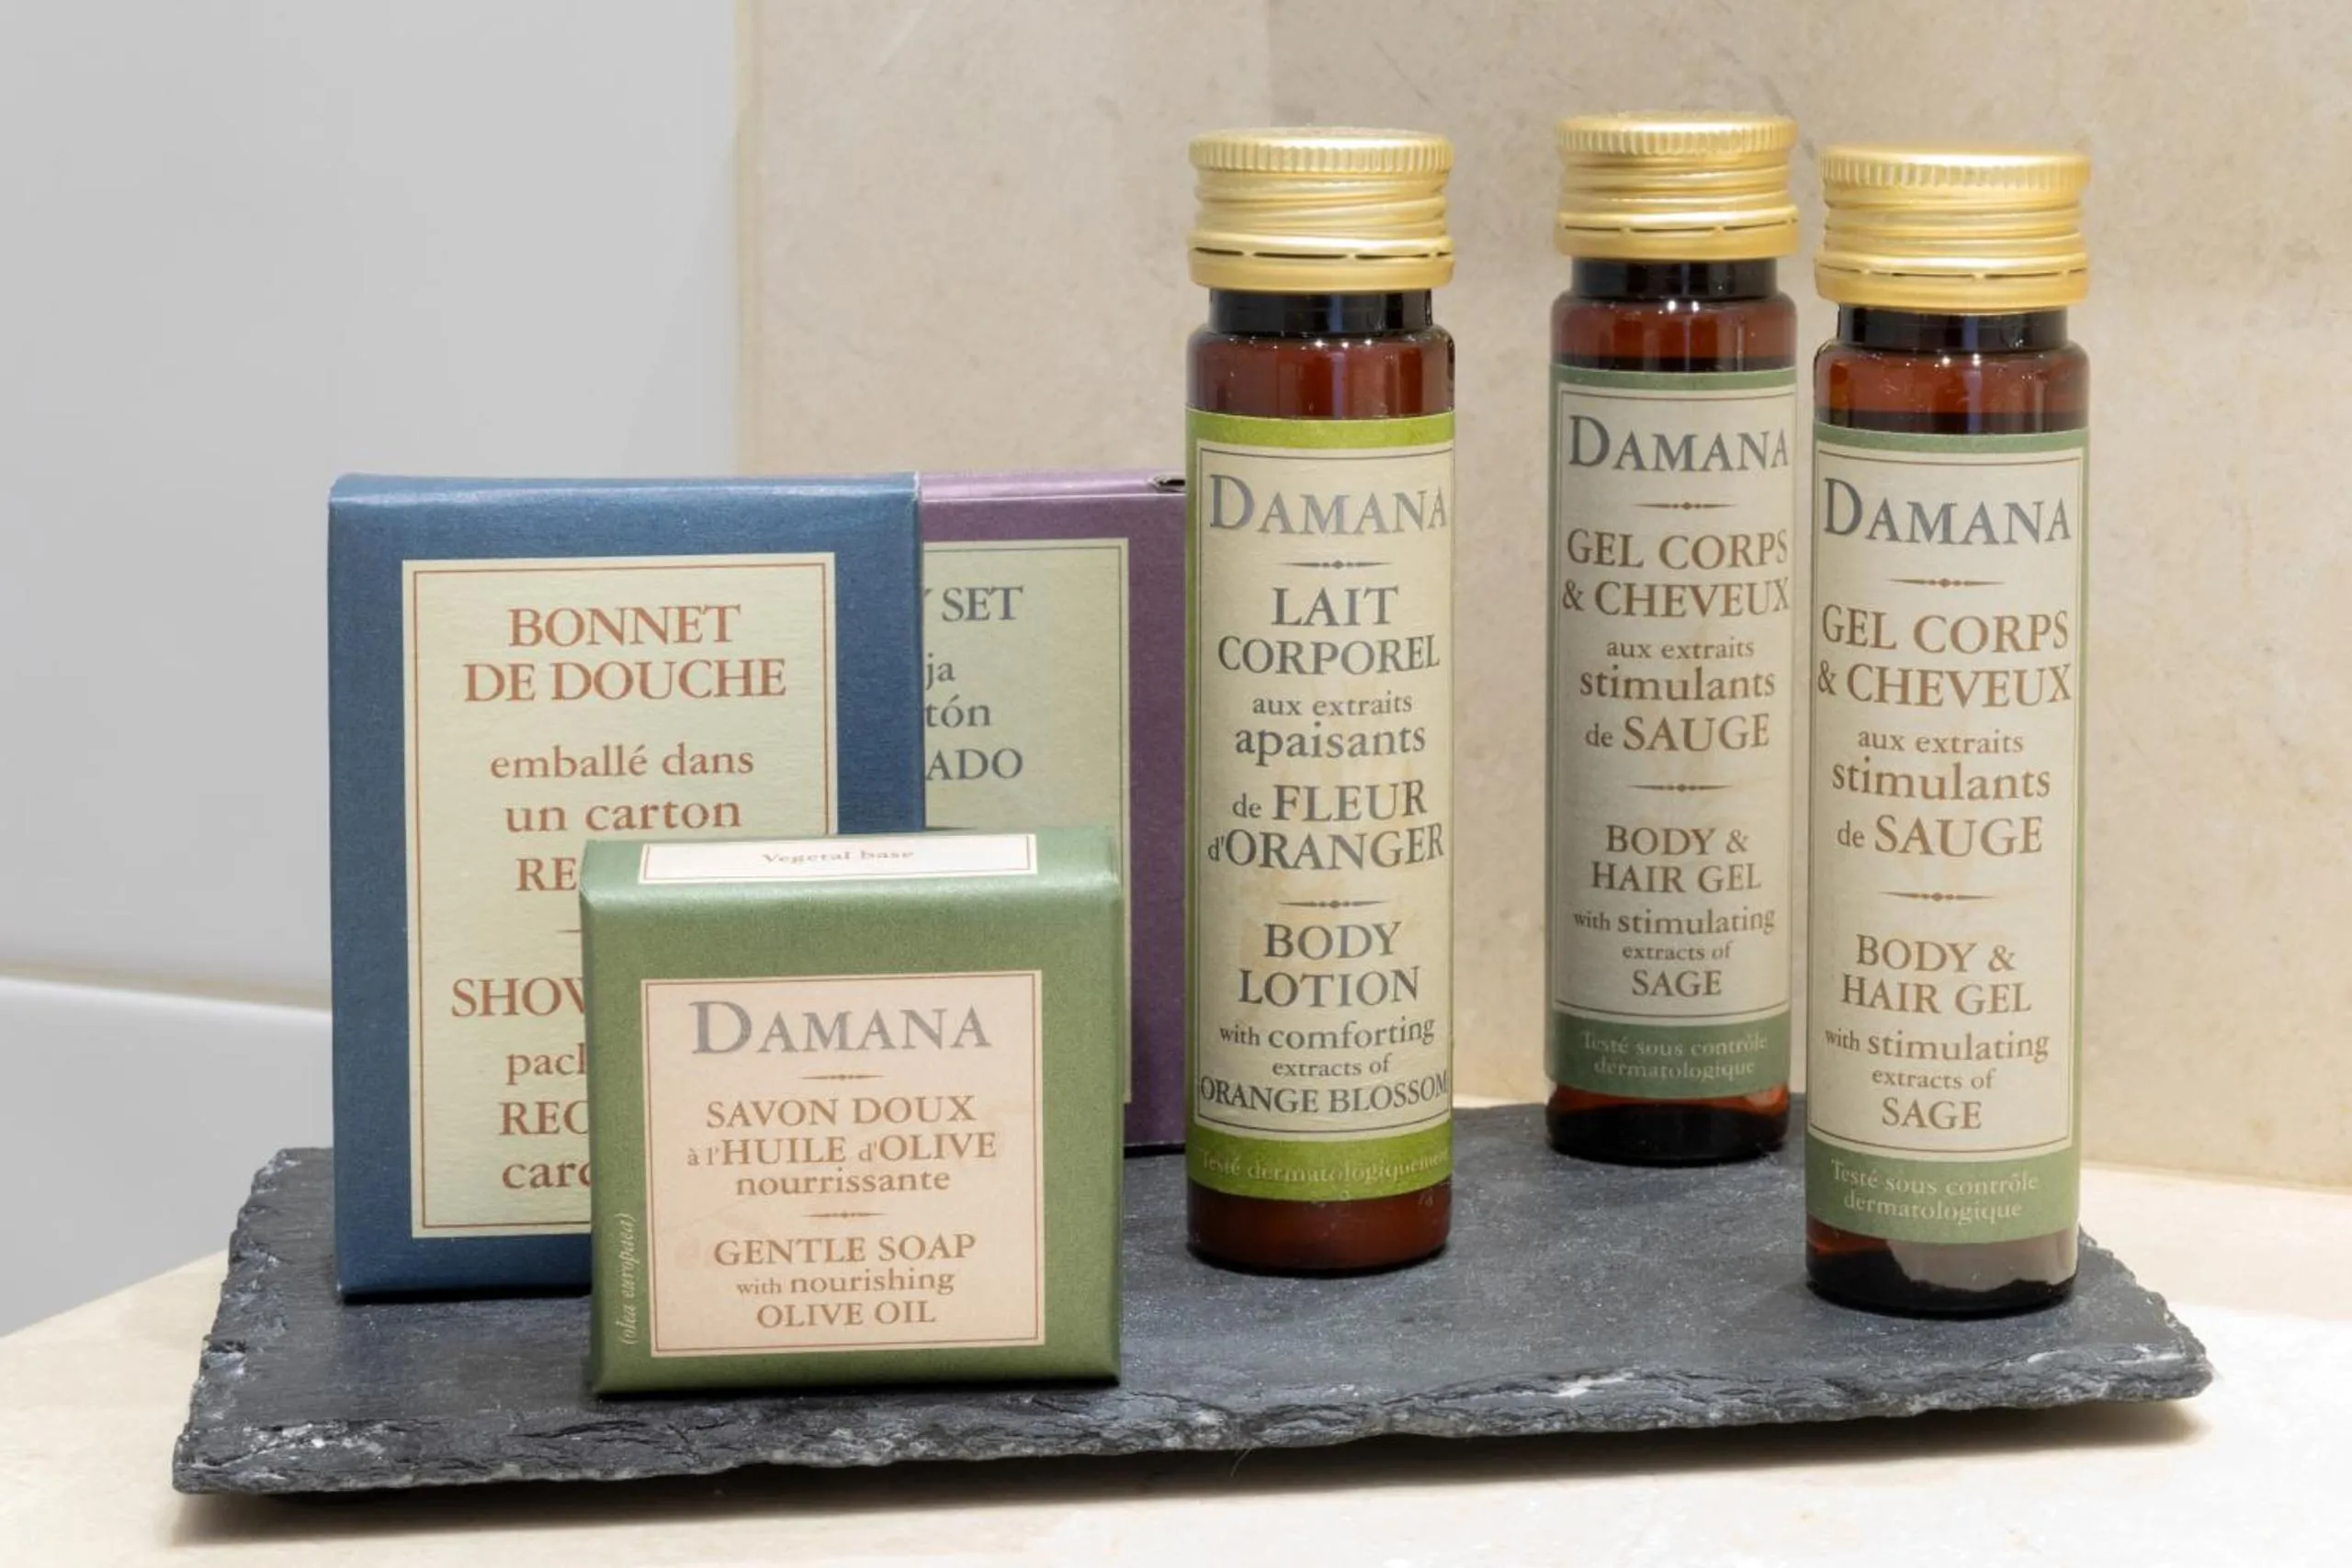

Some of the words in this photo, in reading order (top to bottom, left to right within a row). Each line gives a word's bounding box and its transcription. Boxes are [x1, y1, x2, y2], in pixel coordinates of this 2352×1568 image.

[1568, 414, 1789, 472] DAMANA
[1209, 474, 1448, 536] DAMANA
[1823, 477, 2072, 545] DAMANA
[1567, 527, 1645, 568] GEL
[1658, 528, 1789, 570] CORPS
[942, 585, 1023, 622] SET
[1271, 585, 1399, 626] LAIT
[1563, 579, 1584, 612] &
[1595, 576, 1789, 618] CHEVEUX
[507, 604, 741, 648] BONNET
[1822, 604, 1897, 649] GEL
[1913, 610, 2069, 655] CORPS
[1217, 634, 1441, 675] CORPOREL
[1606, 640, 1653, 660] aux
[1661, 636, 1755, 660] extraits
[463, 663, 536, 703] DE
[550, 658, 787, 701] DOUCHE
[1579, 664, 1776, 702] stimulants
[1817, 660, 1838, 695] &
[1846, 663, 2072, 708] CHEVEUX
[1252, 696, 1303, 716] aux
[1312, 690, 1413, 716] extraits
[1235, 720, 1426, 767] apaisants
[1585, 722, 1614, 748] de
[1623, 713, 1770, 752] SAUGE
[1858, 729, 1905, 751] aux
[1916, 728, 2023, 754] extraits
[490, 743, 648, 779] emballé
[662, 742, 754, 774] dans
[1832, 755, 2051, 801] stimulants
[505, 806, 567, 833] un
[584, 798, 742, 830] carton
[1232, 792, 1262, 818] de
[1271, 779, 1428, 822] FLEUR
[1207, 822, 1445, 871] d'ORANGER
[1606, 824, 1717, 855] BODY
[1725, 829, 1749, 854] &
[1838, 819, 1865, 848] de
[1874, 814, 2043, 857] SAUGE
[763, 851, 851, 864] Vegetal
[860, 850, 915, 861] base
[1590, 861, 1687, 894] HAIR
[1698, 862, 1762, 894] GEL
[1572, 909, 1611, 931] with
[1617, 906, 1776, 935] stimulating
[1264, 920, 1402, 961] BODY
[1622, 942, 1706, 962] extracts
[1711, 941, 1734, 960] of
[1855, 933, 1978, 973] BODY
[1987, 944, 2016, 973] &
[1237, 965, 1420, 1008] LOTION
[1632, 969, 1723, 998] SAGE
[1840, 974, 1941, 1014] HAIR
[1954, 982, 2032, 1015] GEL
[688, 999, 992, 1055] DAMANA
[1219, 1023, 1261, 1047] with
[1268, 1015, 1436, 1050] comforting
[1581, 1030, 1629, 1055] Testé
[1635, 1041, 1683, 1057] sous
[1690, 1032, 1769, 1057] contrôle
[1825, 1028, 1860, 1051] with
[1868, 1031, 2051, 1064] stimulating
[1272, 1059, 1362, 1077] extracts
[1369, 1053, 1393, 1075] of
[1593, 1056, 1756, 1081] dermatologique
[1871, 1067, 1962, 1089] extracts
[1971, 1068, 1996, 1089] of
[1200, 1076, 1318, 1113] ORANGE
[1328, 1068, 1449, 1113] BLOSSOM
[707, 1099, 839, 1129] SAVON
[853, 1095, 978, 1124] DOUX
[1882, 1098, 1982, 1130] SAGE
[687, 1147, 700, 1167] à
[707, 1136, 846, 1166] l'HUILE
[858, 1132, 997, 1163] d'OLIVE
[736, 1167, 951, 1197] nourrissante
[1831, 1160, 1878, 1189] Testé
[1885, 1179, 1939, 1195] sous
[1946, 1171, 2040, 1195] contrôle
[1843, 1190, 2022, 1226] dermatologique
[714, 1236, 866, 1267] GENTLE
[878, 1233, 977, 1261] SOAP
[737, 1276, 783, 1296] with
[789, 1268, 955, 1297] nourishing
[756, 1303, 865, 1329] OLIVE
[874, 1300, 936, 1325] OIL
